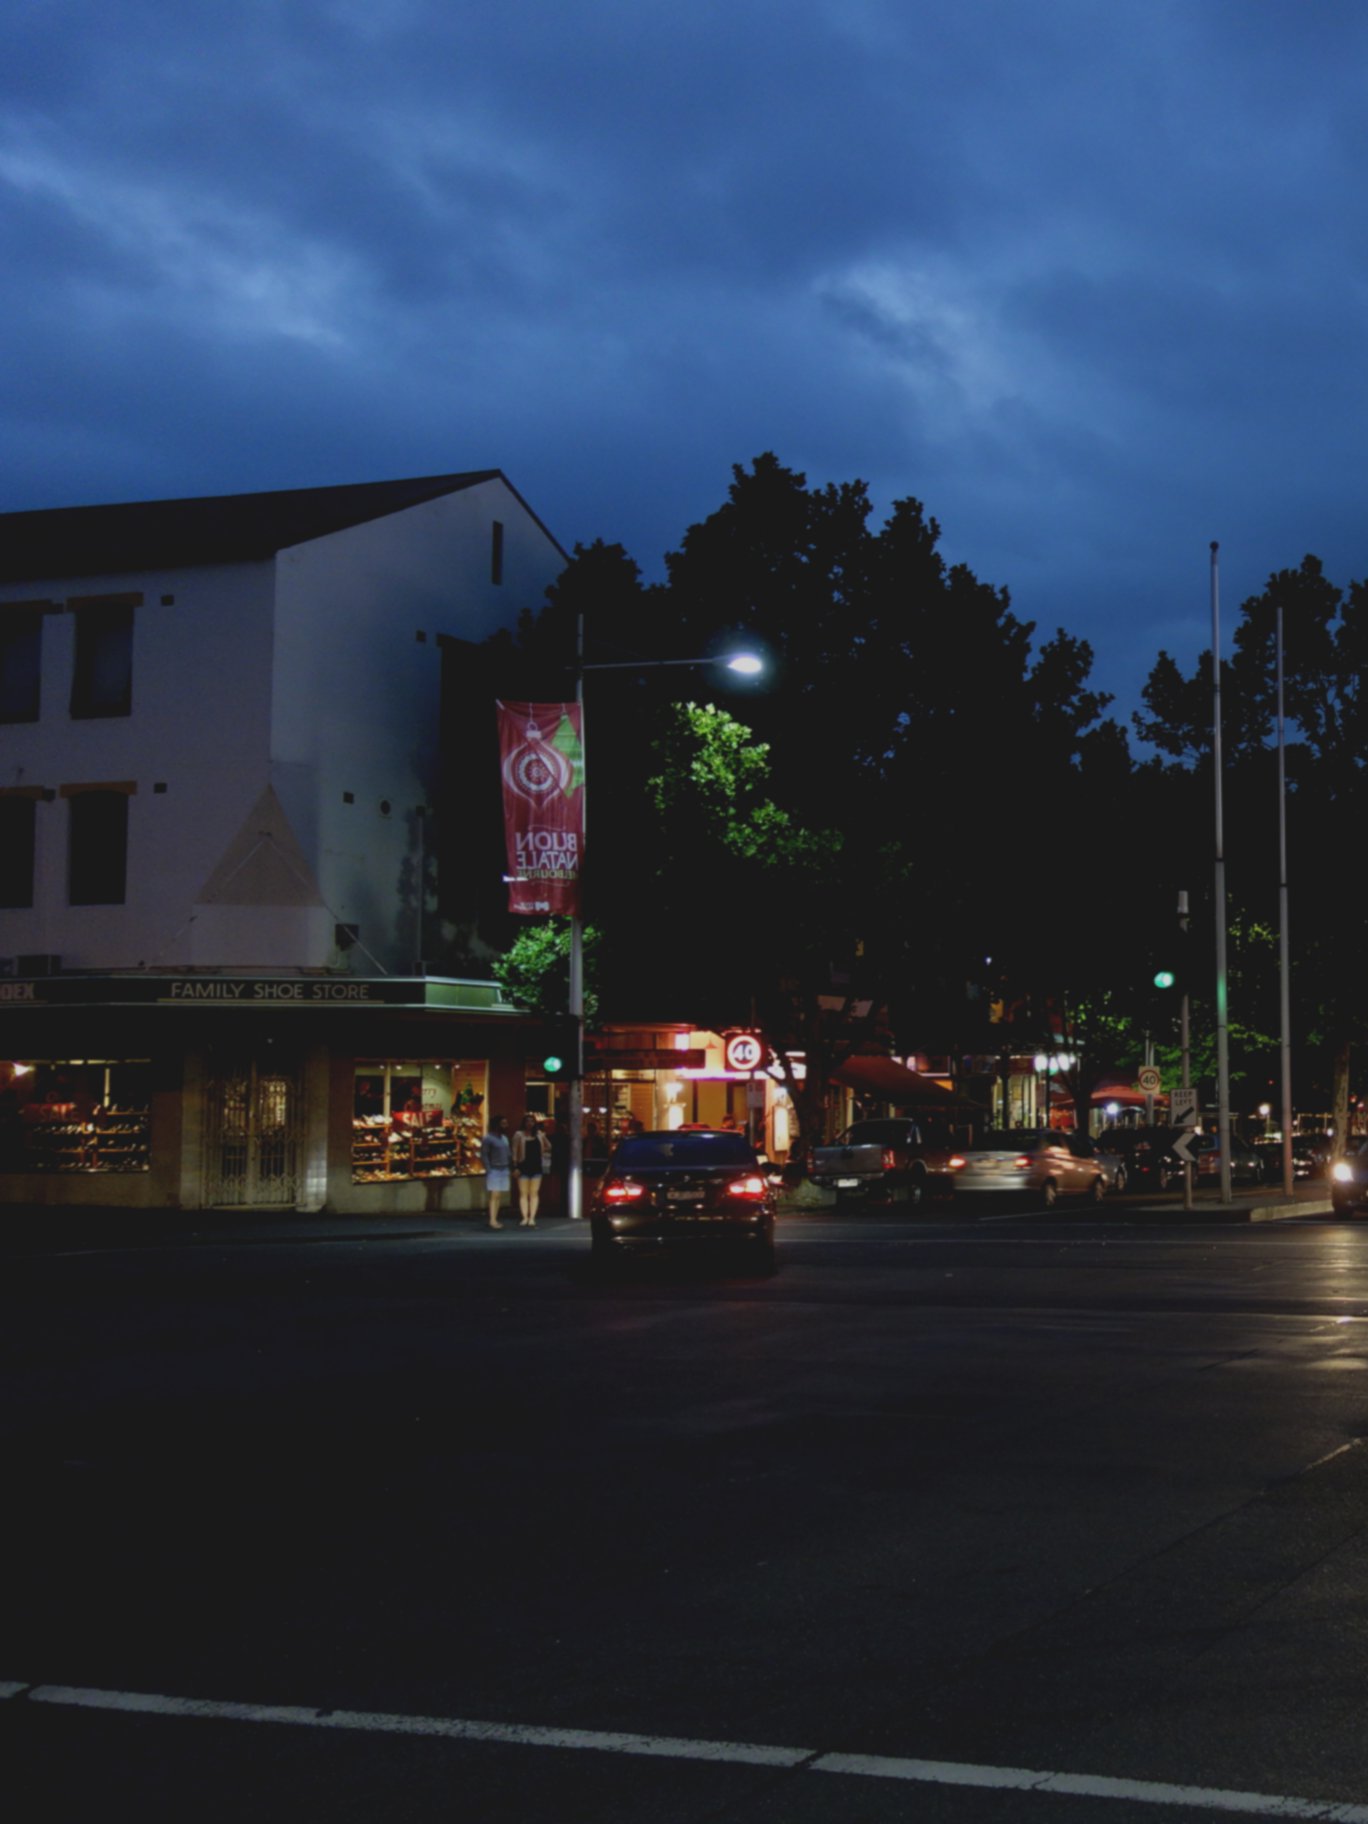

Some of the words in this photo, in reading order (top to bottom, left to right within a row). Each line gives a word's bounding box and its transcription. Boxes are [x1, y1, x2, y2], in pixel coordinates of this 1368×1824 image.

[170, 982, 245, 998] FAMILY
[252, 983, 304, 999] SHOE
[311, 984, 370, 999] STORE
[732, 1043, 755, 1062] 40
[1143, 1075, 1155, 1085] 40
[402, 1110, 433, 1127] SALE
